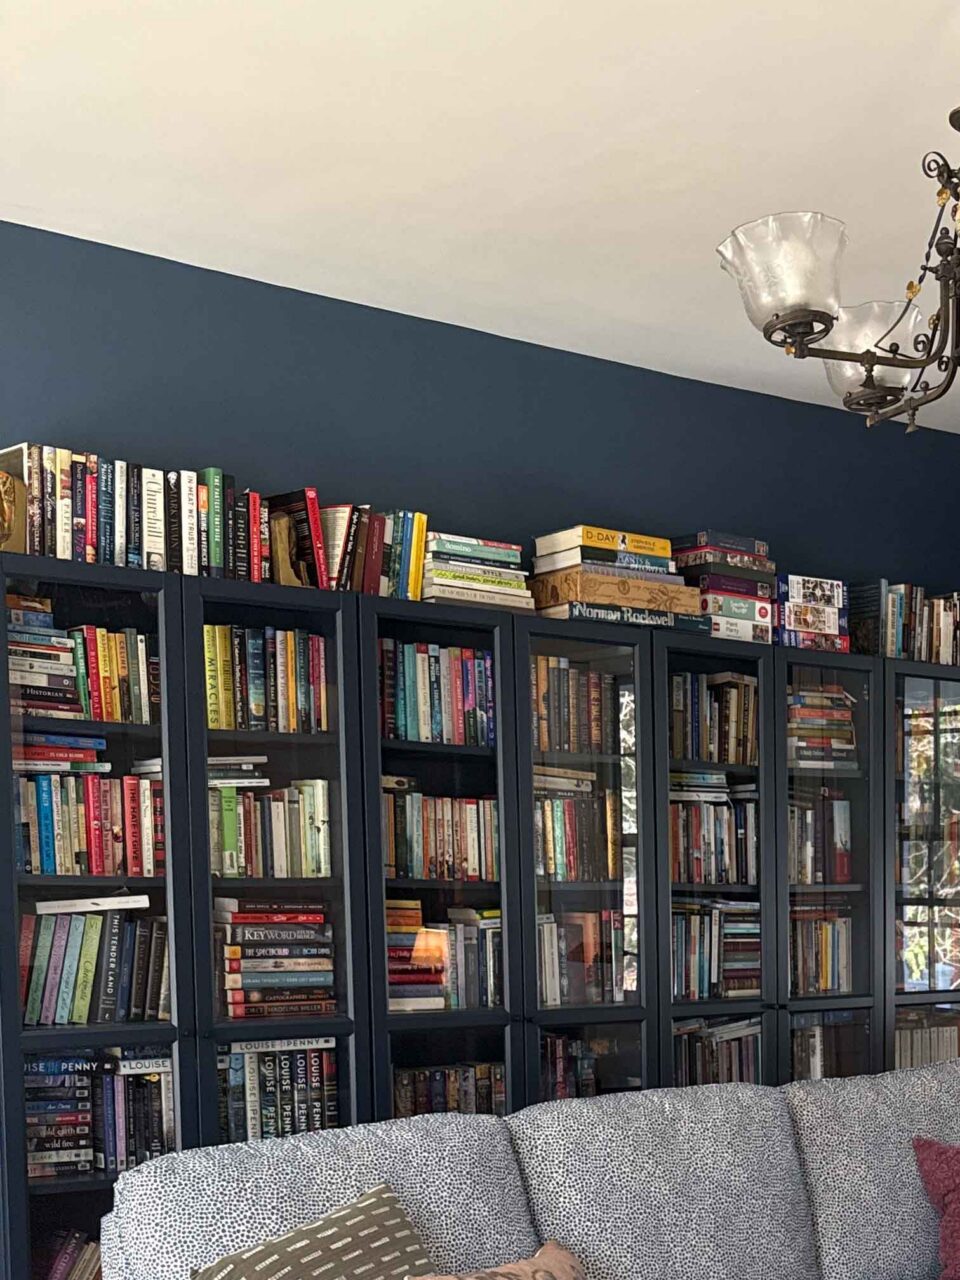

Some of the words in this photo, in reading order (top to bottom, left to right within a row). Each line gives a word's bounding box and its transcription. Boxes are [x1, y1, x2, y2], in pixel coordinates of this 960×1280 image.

[187, 475, 194, 484] IN
[169, 488, 179, 515] MARK
[187, 486, 195, 506] MEAT
[146, 481, 163, 538] Churchill
[188, 509, 195, 518] WE
[75, 534, 85, 553] 1776
[169, 518, 179, 548] TWAIN
[586, 531, 616, 543] D-DAY
[444, 543, 472, 552] domino
[573, 602, 620, 620] Norman
[621, 606, 675, 626] Rockwell
[207, 656, 219, 724] MIRACLES
[130, 806, 138, 829] HATE
[111, 915, 120, 933] THIS
[108, 936, 118, 968] TENDER
[106, 971, 115, 994] LAND
[239, 1042, 276, 1051] LOUISE
[287, 1039, 321, 1048] PENNY
[23, 1062, 45, 1072] ISE
[61, 1062, 98, 1072] PENNY
[129, 1060, 169, 1070] LOUISE
[264, 1056, 274, 1093] LOUISE
[281, 1055, 291, 1091] LOUISE
[296, 1054, 306, 1090] LOUISE
[311, 1052, 321, 1089] LOUISE
[248, 1061, 257, 1098] LOUISE
[250, 1108, 259, 1138] PENN
[312, 1102, 321, 1130] PENN
